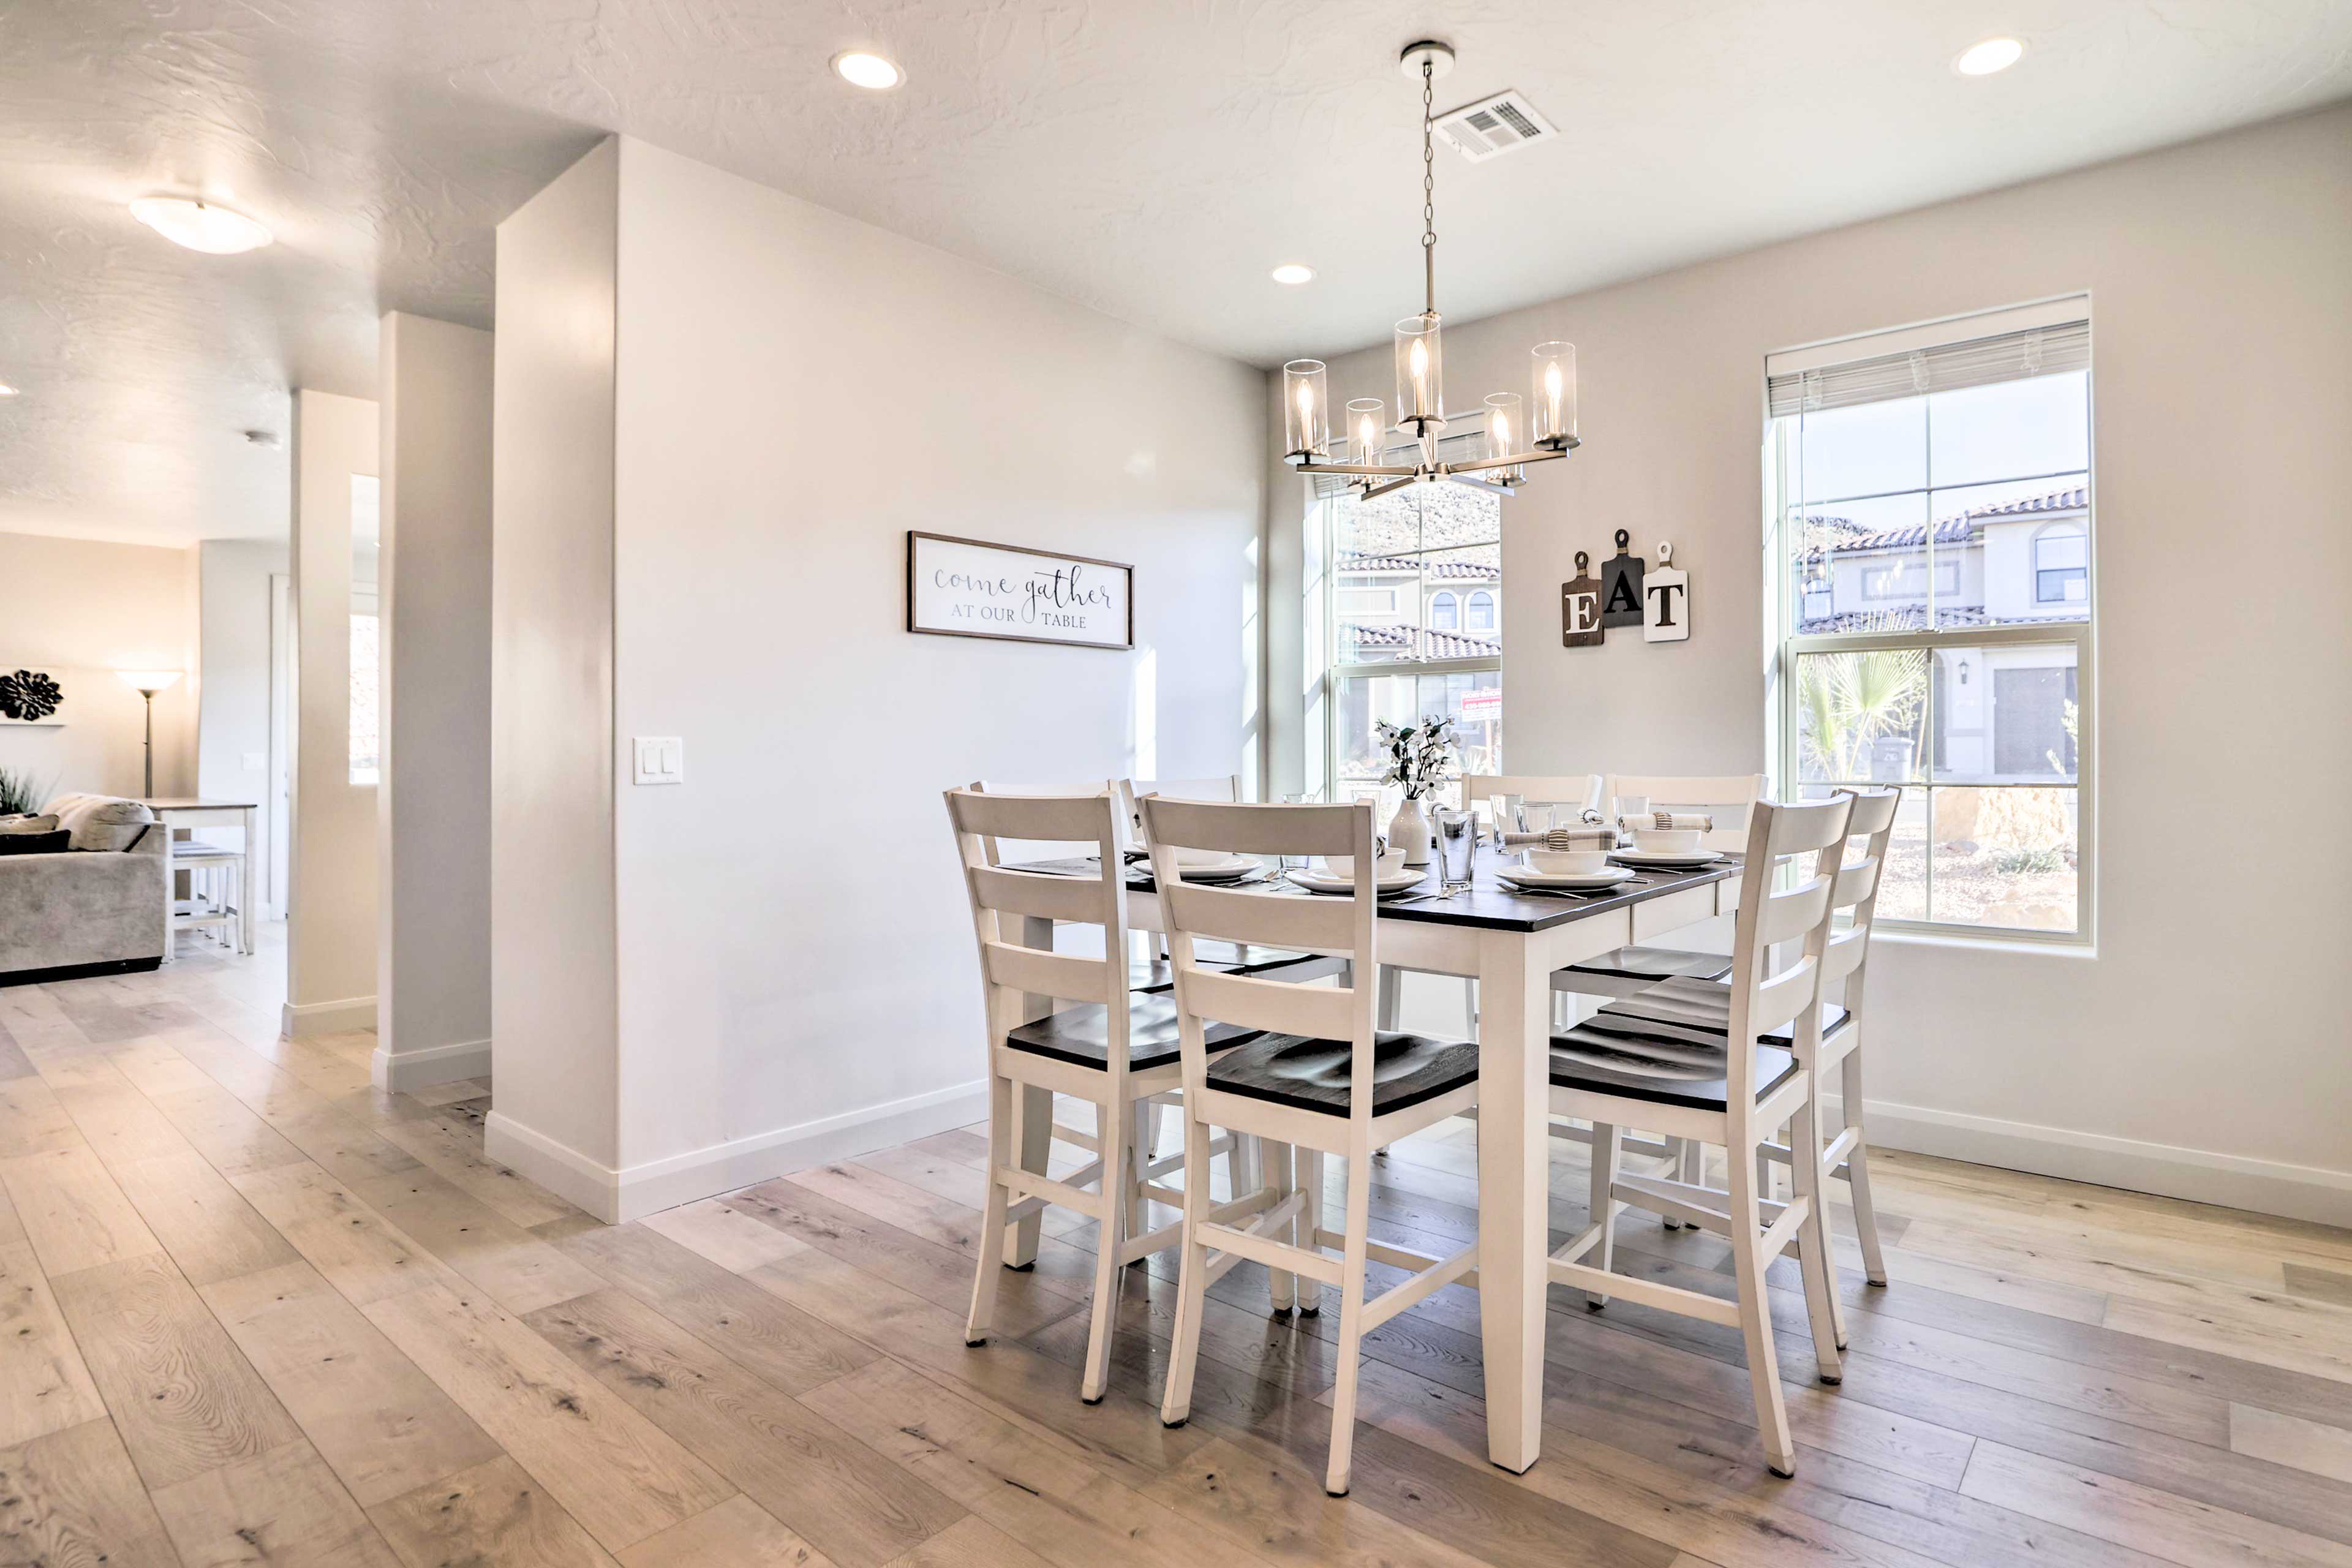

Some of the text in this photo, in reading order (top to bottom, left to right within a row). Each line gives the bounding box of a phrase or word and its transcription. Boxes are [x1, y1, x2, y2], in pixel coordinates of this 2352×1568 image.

[934, 565, 1112, 624] come gather
[951, 603, 1087, 629] AT OUR TABLE
[1565, 570, 1684, 634] EAT
